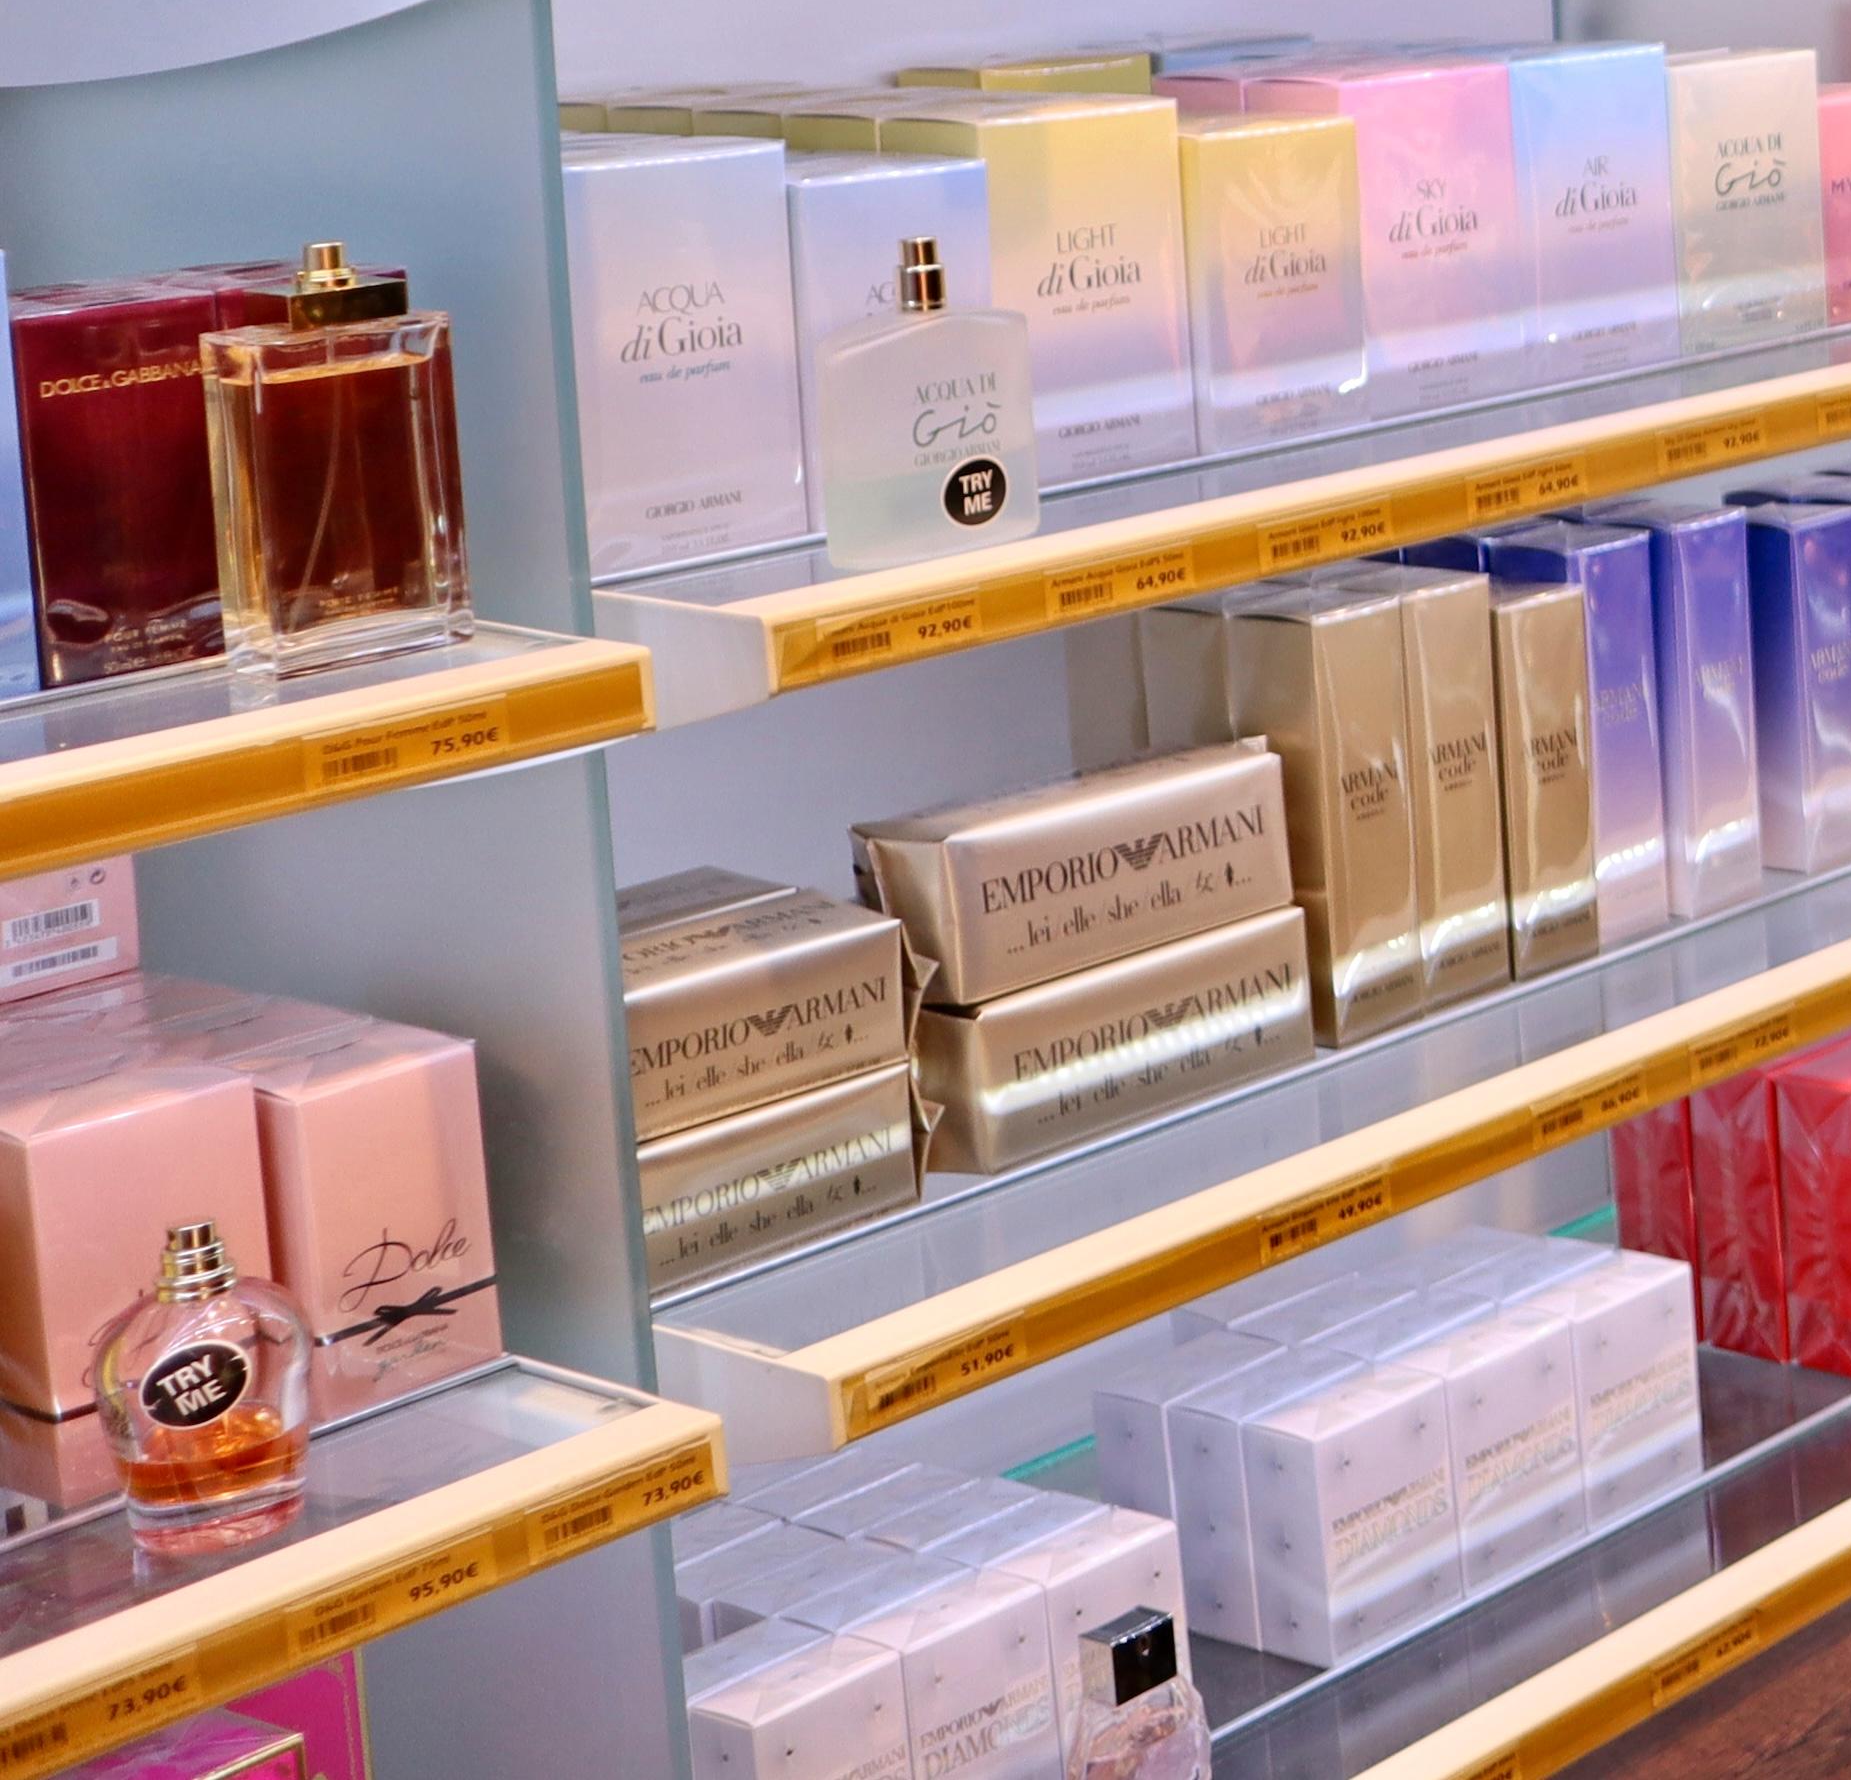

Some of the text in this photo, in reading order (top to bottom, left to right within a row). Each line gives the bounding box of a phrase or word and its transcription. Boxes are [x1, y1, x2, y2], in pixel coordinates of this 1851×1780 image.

[1714, 132, 1783, 160] ACQUA DI
[1582, 154, 1609, 177] AIR
[1714, 157, 1788, 198] Giò
[1416, 179, 1447, 201] SKY
[1555, 181, 1637, 218] di Gioia
[1055, 222, 1119, 255] LIGHT
[1259, 222, 1307, 250] LIGHT
[1389, 204, 1478, 243] di Gioia
[1036, 255, 1142, 299] di Gioia
[1244, 248, 1327, 286] di Gioia
[636, 279, 726, 316] ACQUA
[619, 315, 743, 364] di Gioia
[638, 357, 732, 385] eau de parfum
[913, 371, 998, 405] ACQUA DI
[912, 401, 1002, 449] Giò
[1058, 414, 1141, 439] GIORGIO ARMANI
[913, 440, 1001, 469] GIORGIO ARMANI
[958, 469, 994, 496] TRY
[645, 489, 743, 520] GIORGIO ARMANI
[963, 491, 993, 517] ME
[917, 614, 973, 641] 92,90€
[429, 726, 500, 758] 75,90€
[1340, 761, 1399, 795] ARMANI
[1437, 754, 1477, 781] code
[1350, 785, 1390, 811] code
[980, 804, 1266, 915] EMPORIO ARMANI
[1063, 880, 1182, 939] elle she ella
[629, 976, 888, 1078] EMPORIO ARMANI
[1012, 1014, 1150, 1082] EMPORIO
[1184, 962, 1294, 1021] ARMANI
[696, 1038, 805, 1091] elle she ella
[1093, 1046, 1211, 1104] elle she ella
[641, 1127, 894, 1235] EMPORIO ARMANI
[708, 1195, 816, 1250] elle she ella
[339, 1217, 472, 1313] Dolce
[157, 1354, 215, 1398] TRY
[960, 1343, 1016, 1377] 51,90€
[173, 1378, 228, 1419] ME
[642, 1469, 705, 1509] 73,90€
[408, 1560, 480, 1603] 95,90€
[109, 1674, 187, 1723] 73,90€
[919, 1707, 983, 1748] EMPORIO
